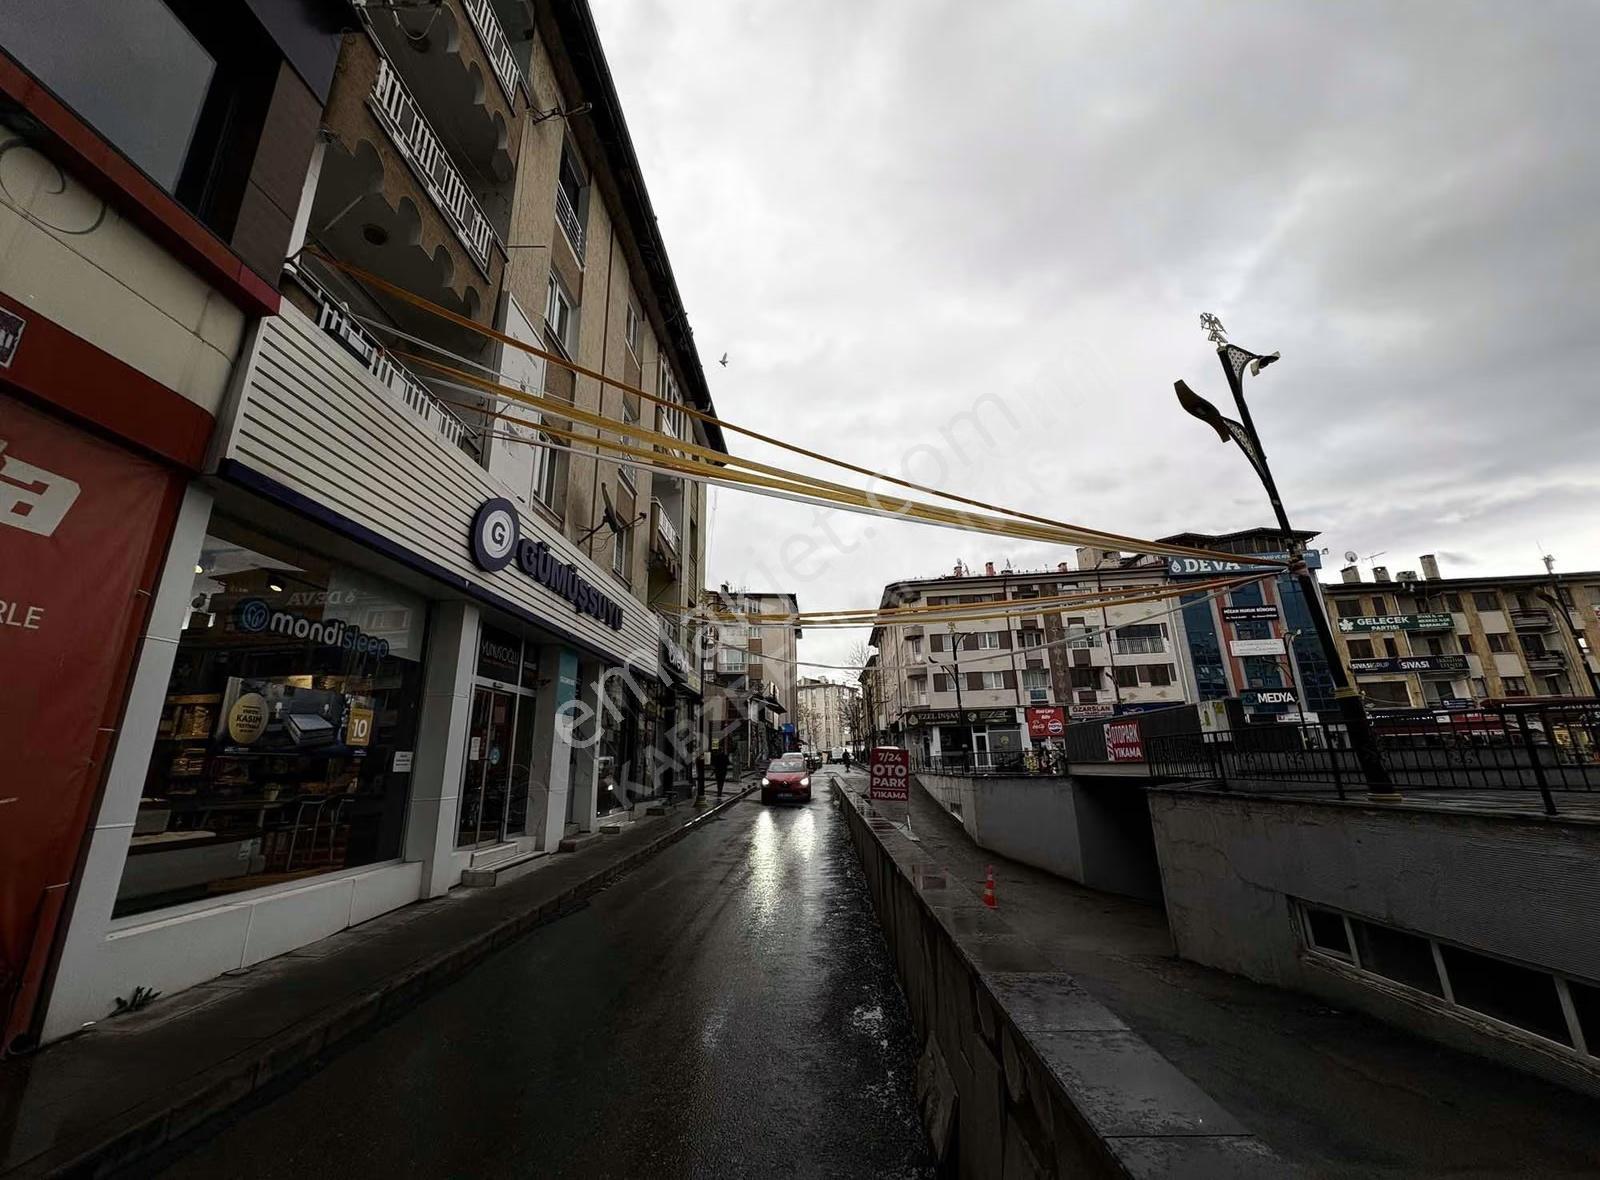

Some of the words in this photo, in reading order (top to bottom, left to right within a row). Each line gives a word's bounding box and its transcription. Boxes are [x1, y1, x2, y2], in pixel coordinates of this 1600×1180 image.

[0, 439, 82, 537] a
[1185, 558, 1241, 573] DEVA
[518, 536, 624, 631] GÜMÜŞSUYU
[1357, 616, 1410, 626] GELECEK
[269, 611, 391, 661] mondisleep
[1257, 691, 1296, 704] MEDYA
[353, 718, 368, 738] 10
[1110, 724, 1140, 744] OTOPARK
[878, 752, 902, 763] 7/24
[1114, 746, 1143, 758] YIKAMA
[872, 764, 907, 776] OTO
[872, 777, 906, 788] PARK
[872, 790, 907, 800] YIKAMA
